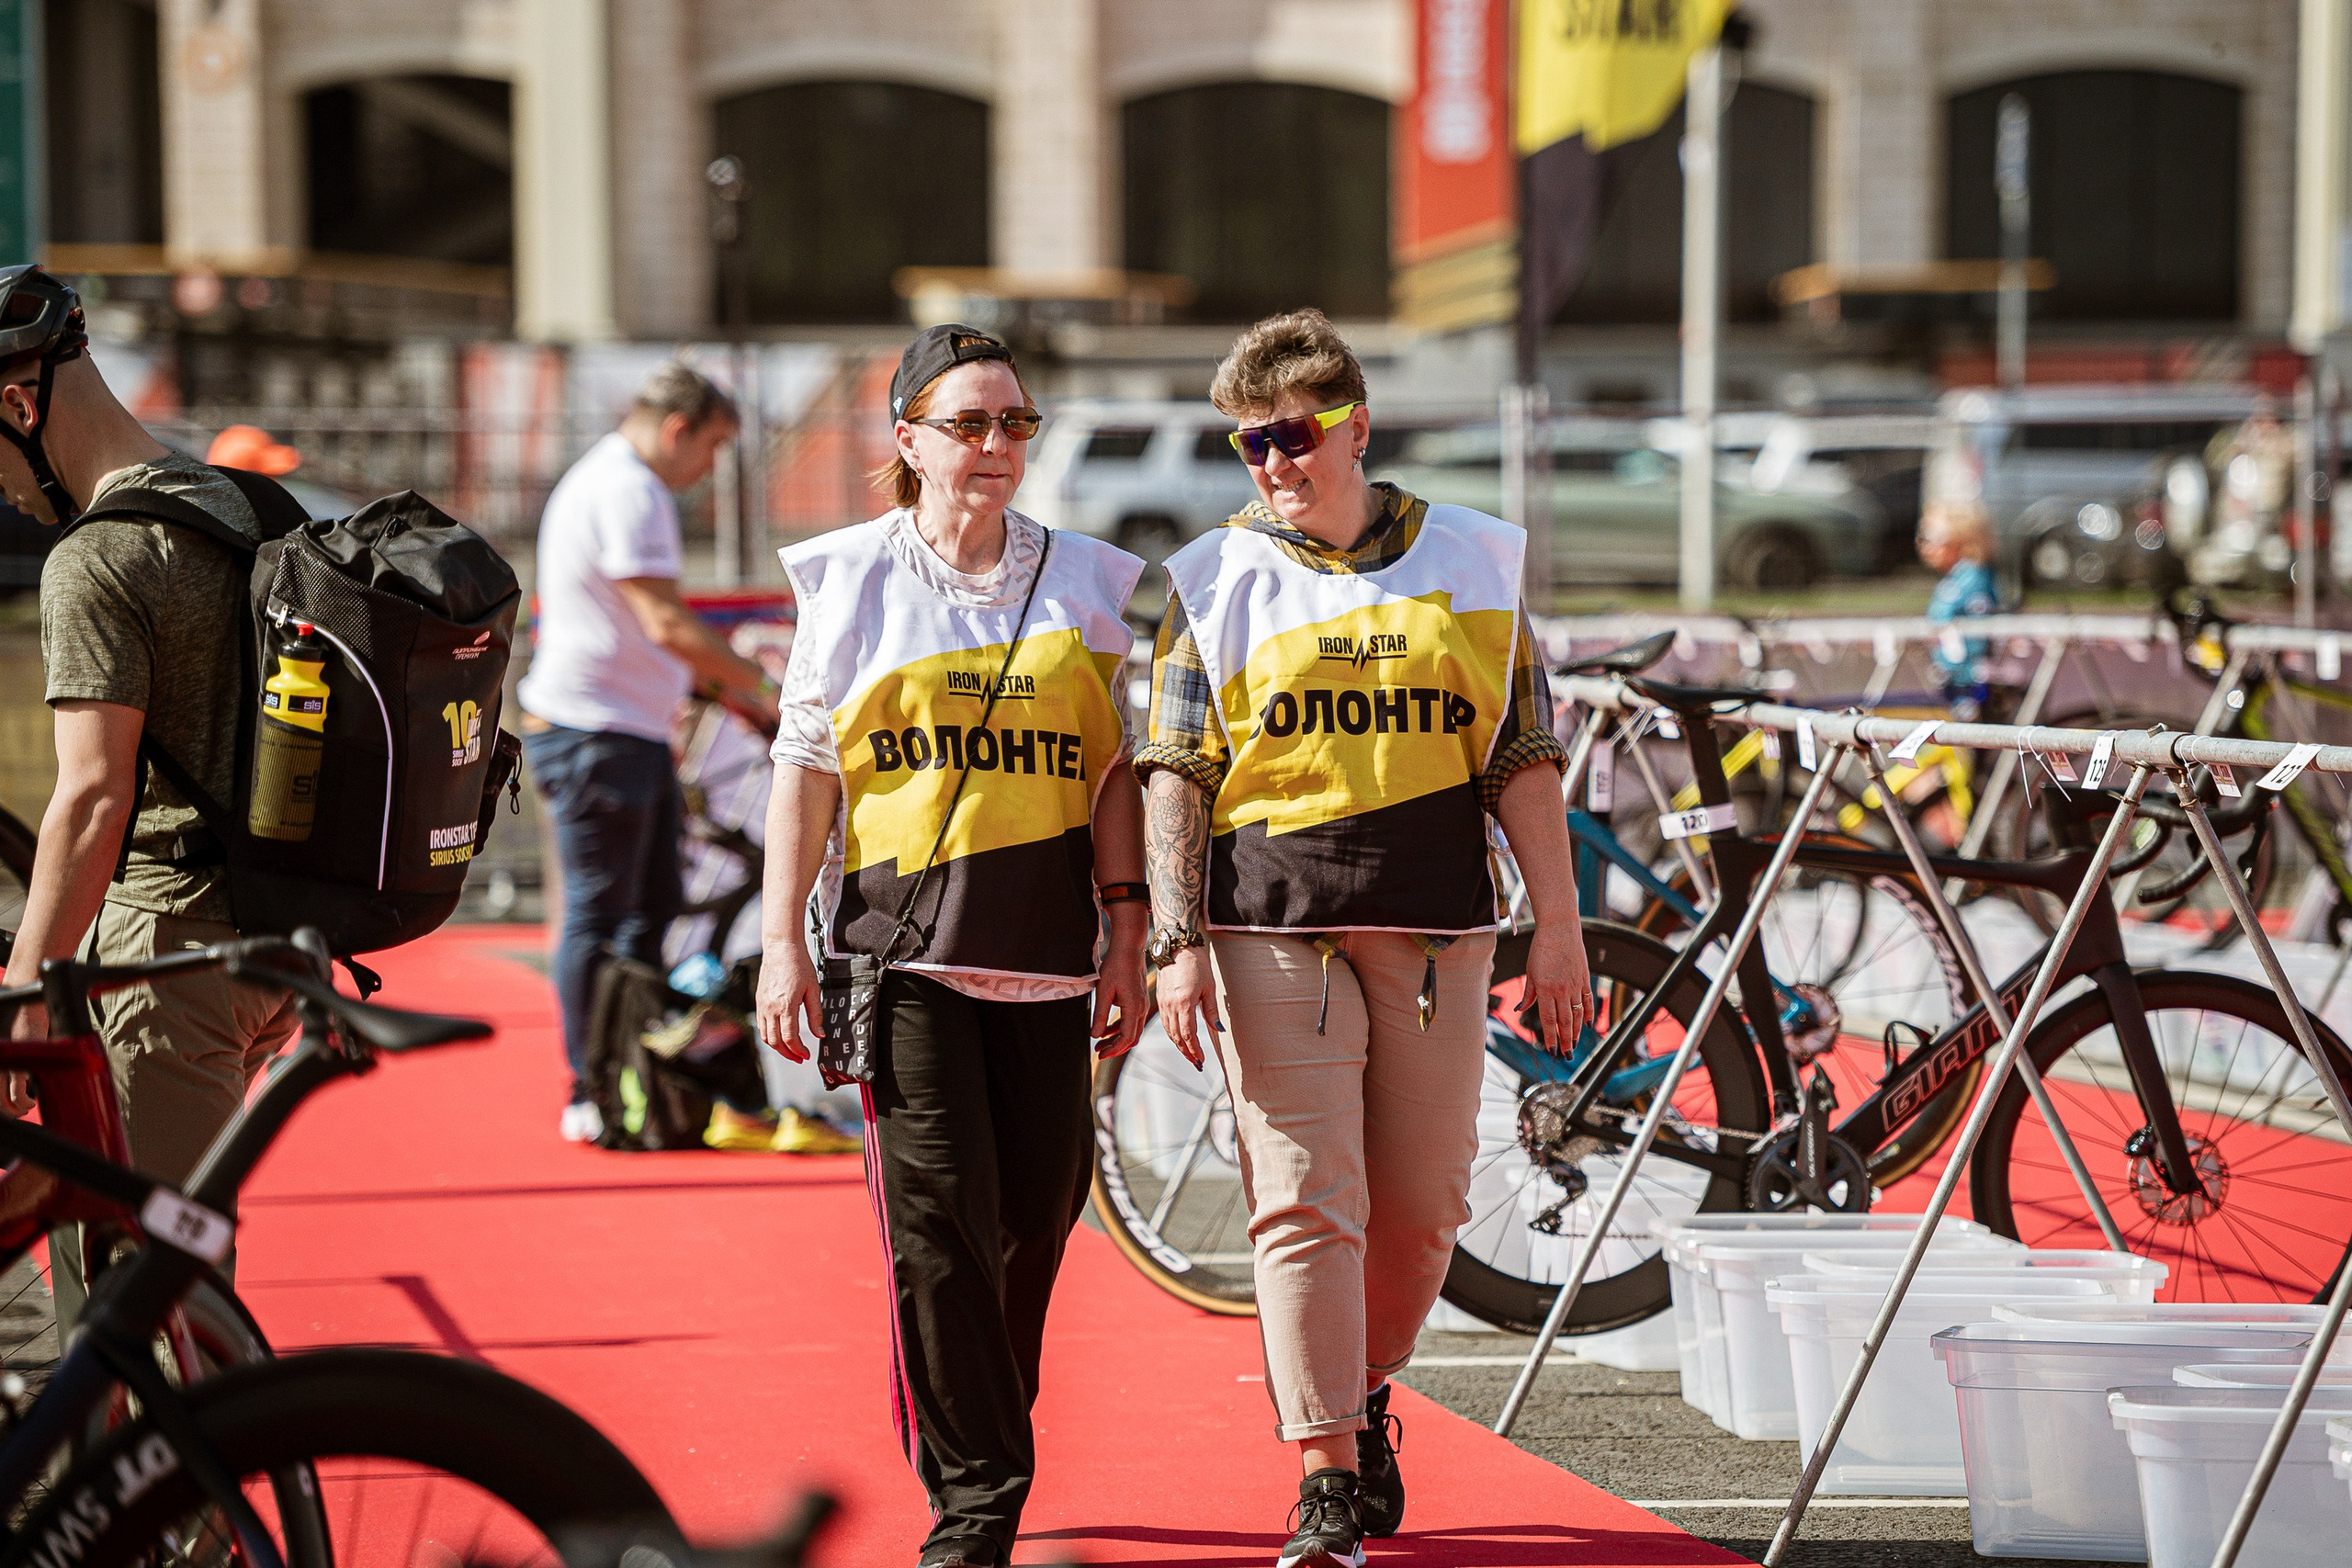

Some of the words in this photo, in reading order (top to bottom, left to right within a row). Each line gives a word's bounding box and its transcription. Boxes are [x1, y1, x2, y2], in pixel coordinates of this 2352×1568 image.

[1317, 637, 1353, 655] IRON
[1369, 633, 1408, 653] STAR
[946, 671, 981, 691] IRON
[997, 675, 1035, 694] STAR
[868, 724, 1086, 781] ВОЛОНТЕ
[430, 824, 470, 850] IRONSTAR
[430, 850, 455, 867] SIRIUS
